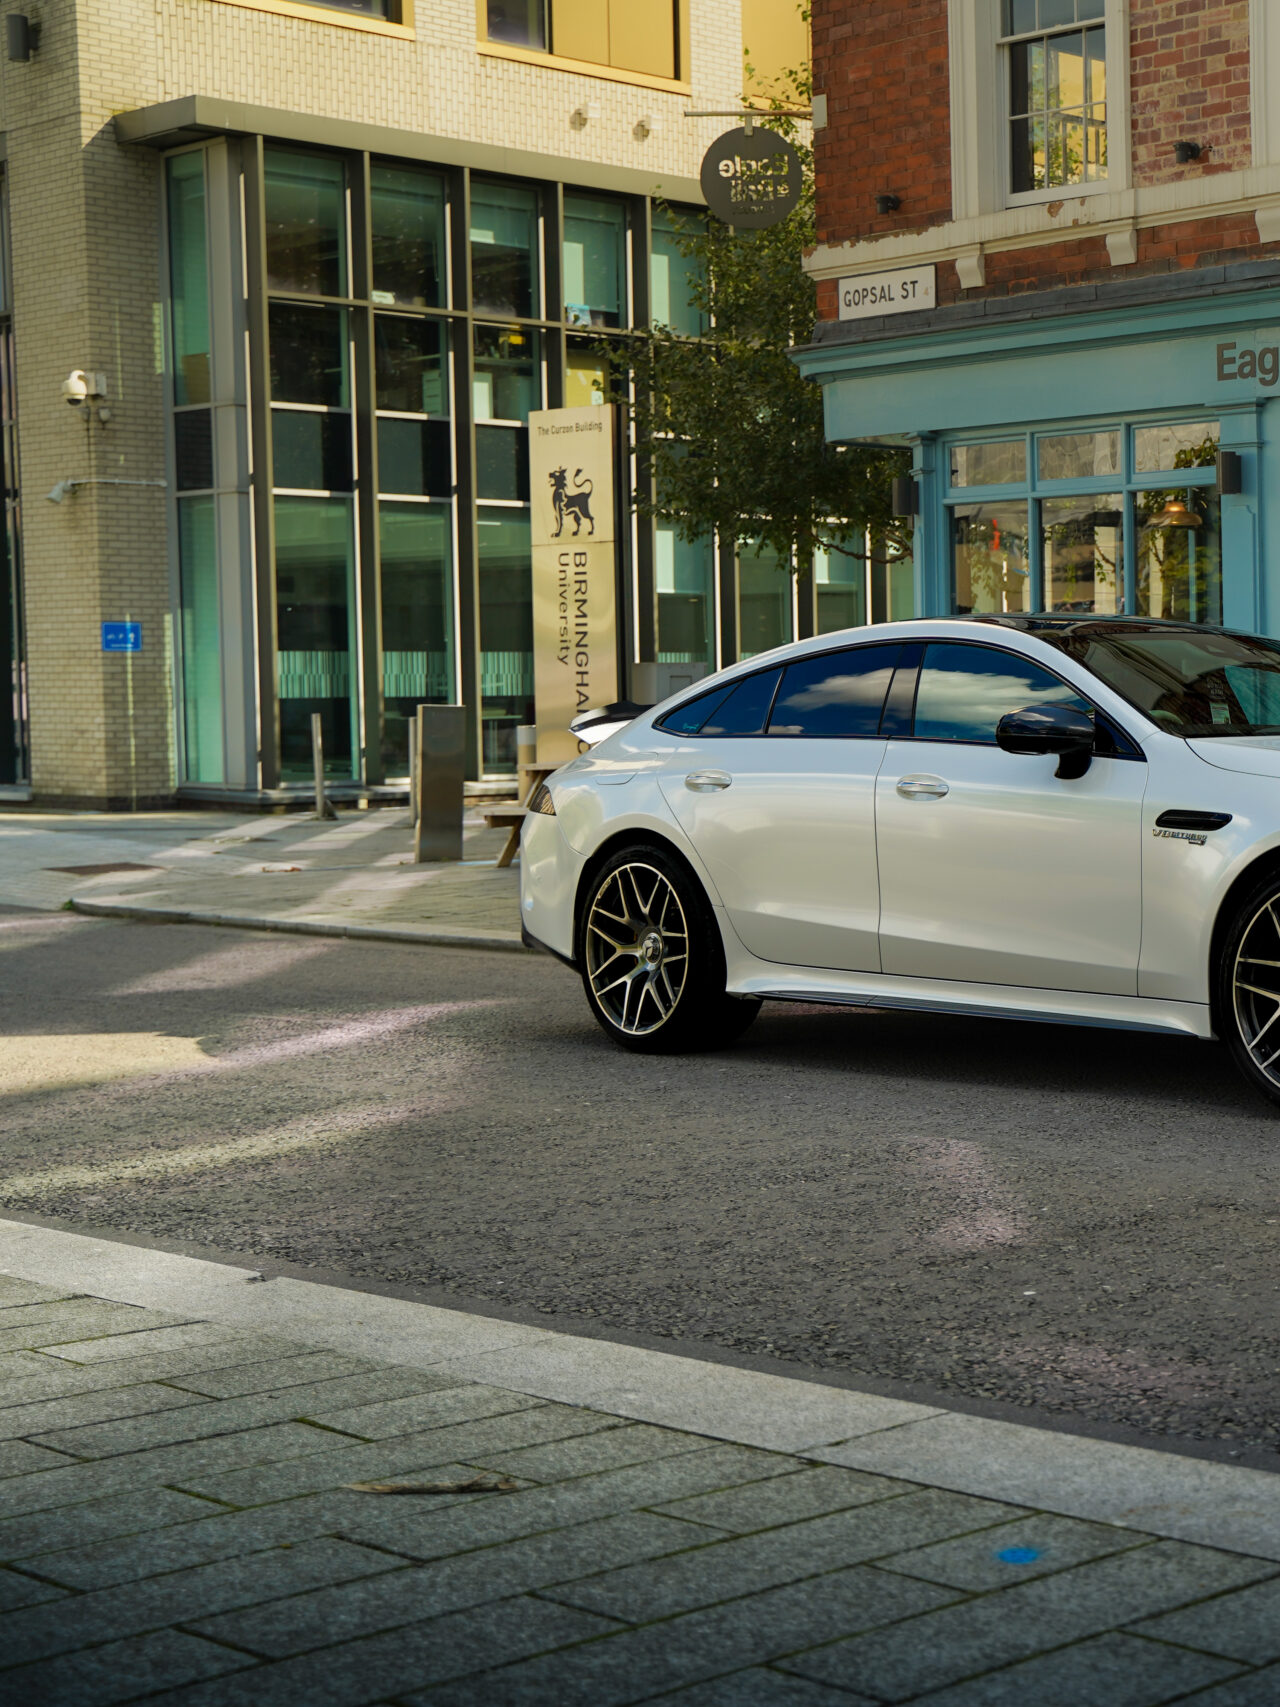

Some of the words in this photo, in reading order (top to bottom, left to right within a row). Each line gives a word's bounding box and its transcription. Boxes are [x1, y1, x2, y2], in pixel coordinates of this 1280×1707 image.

[844, 284, 895, 307] GOPSAL
[901, 280, 919, 299] ST
[537, 426, 550, 436] The
[551, 425, 574, 435] Curzon
[575, 421, 603, 432] Building
[557, 552, 570, 666] University
[573, 551, 591, 714] BIRMINGHA
